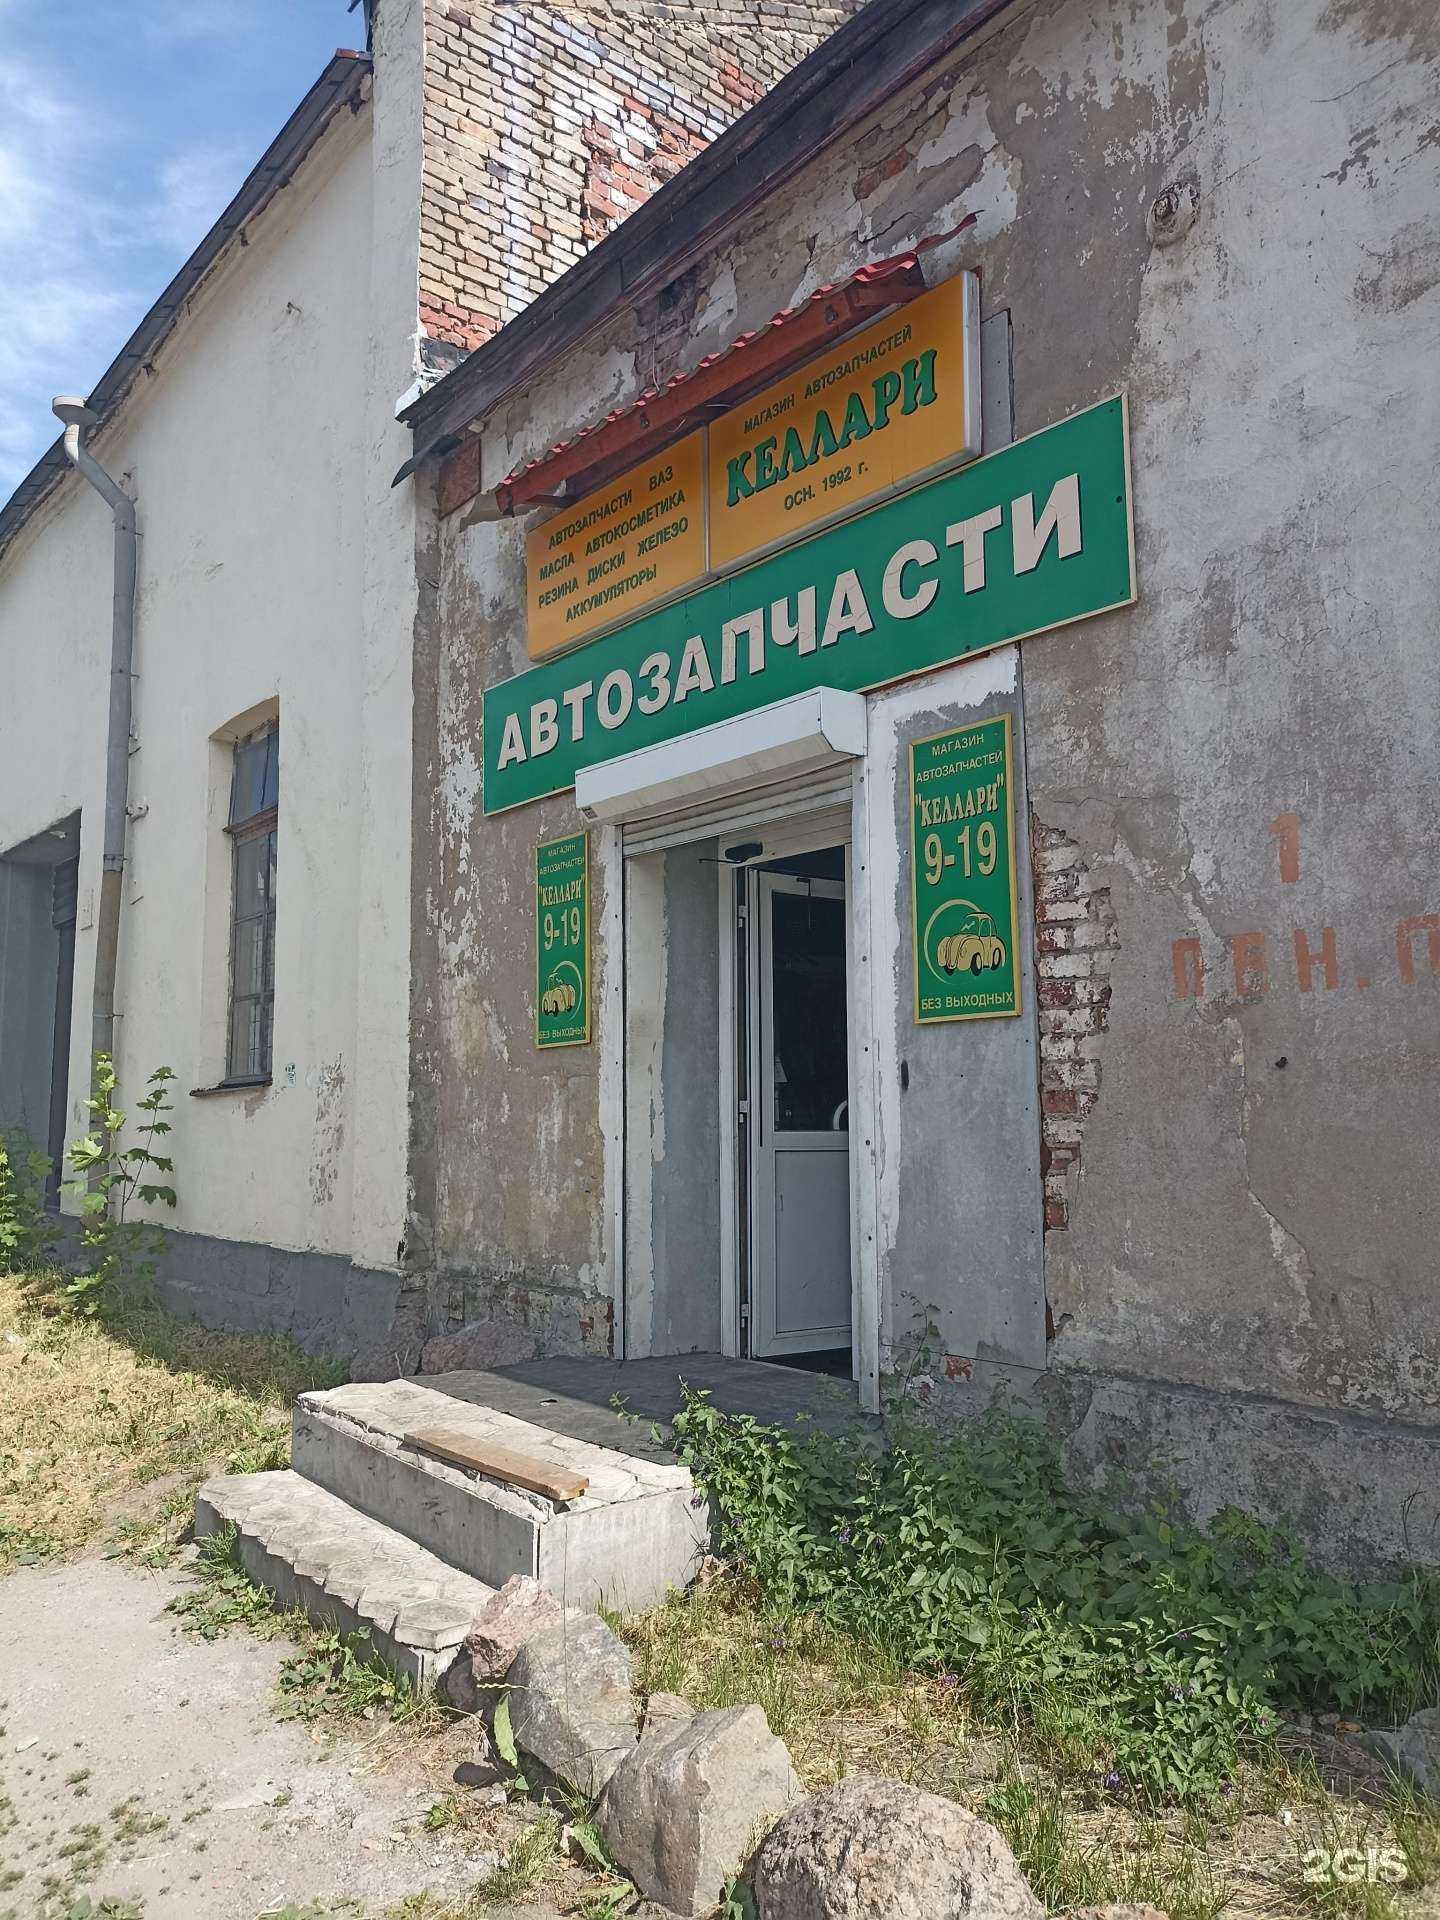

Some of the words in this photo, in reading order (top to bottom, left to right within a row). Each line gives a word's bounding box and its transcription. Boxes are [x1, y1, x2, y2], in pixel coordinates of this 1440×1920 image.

[744, 394, 795, 433] МАГАЗИН
[804, 324, 912, 399] АВТОЗАПЧАСТЕЙ
[726, 349, 938, 507] КЕЛЛАРИ
[548, 488, 633, 550] АВТОЗАПЧАСТИ
[649, 465, 674, 491] ВАЗ
[784, 484, 816, 510] ОСН.
[822, 467, 852, 492] 1992
[857, 461, 869, 475] г.
[538, 576, 579, 608] РЕЗИНА
[587, 551, 625, 586] ДИСКИ
[637, 516, 689, 556] ЖЕЛЕЗО
[539, 551, 575, 581] МАСЛА
[585, 489, 686, 556] АВТОКОСМЕТИКА
[497, 472, 1084, 771] АВТОЗАПЧАСТИ
[566, 563, 657, 622] АККУМУЛЯТОРЫ
[916, 750, 1003, 782] АВТОЗАПЧАСТЕЙ
[932, 733, 984, 757] МАГАЗИН
[547, 844, 576, 857] МАГАЗИН
[924, 821, 998, 886] 9-19
[1268, 812, 1300, 884] 1
[543, 906, 581, 951] 9-19
[921, 998, 942, 1010] БЕЗ
[945, 991, 1013, 1008] ВЫХОДНЫХ
[538, 1030, 550, 1039] БЕЗ
